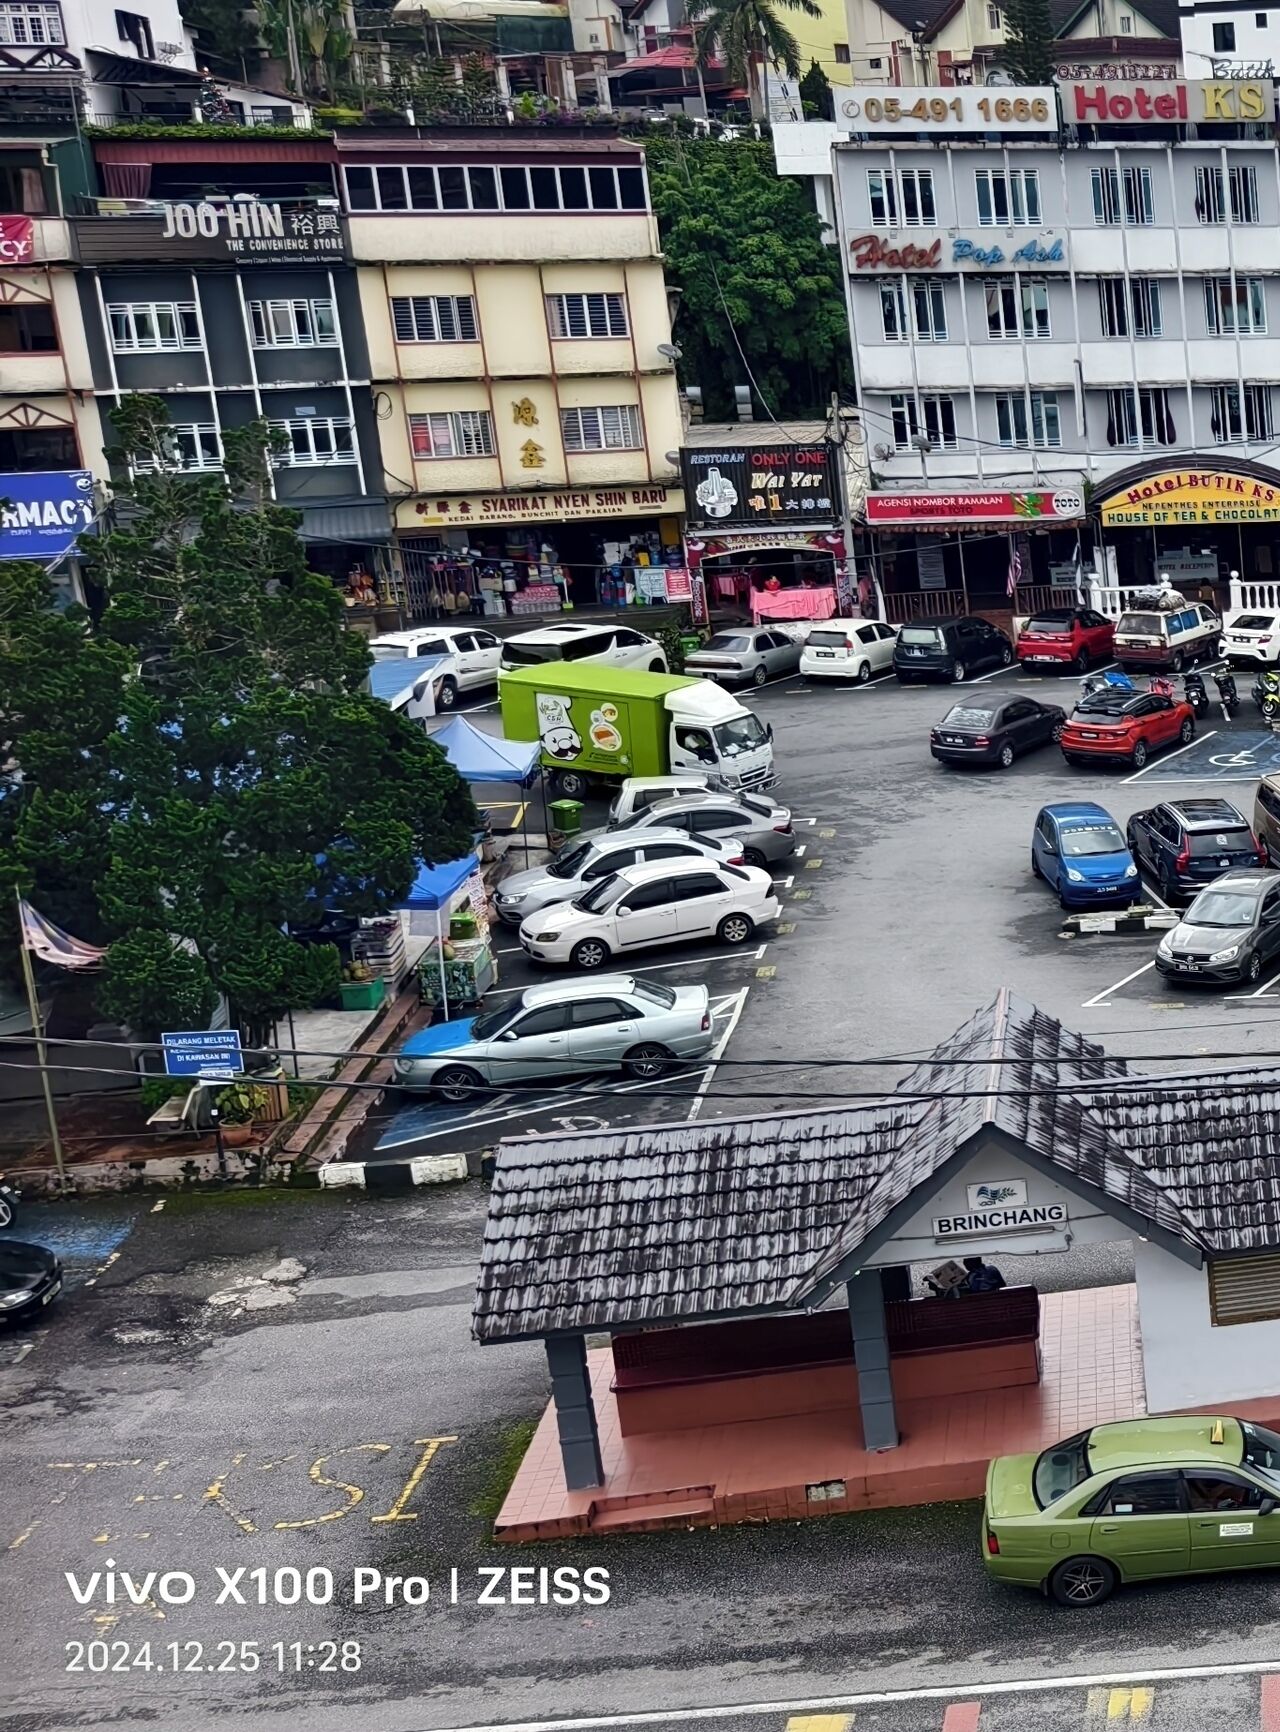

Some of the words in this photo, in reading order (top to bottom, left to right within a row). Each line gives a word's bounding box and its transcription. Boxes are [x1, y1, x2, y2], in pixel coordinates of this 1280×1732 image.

[1074, 85, 1188, 120] Hotel
[1202, 84, 1266, 119] KS
[865, 98, 963, 122] 05-491
[978, 98, 1049, 122] 1666
[163, 203, 219, 239] JOO
[226, 203, 285, 238] HIN
[226, 239, 245, 251] THE
[250, 238, 309, 251] CONVENIENCE
[314, 236, 344, 249] STORE
[850, 235, 942, 269] Hotel
[691, 453, 745, 465] RESTORAN
[752, 453, 791, 466] ONLY
[795, 451, 826, 464] ONE
[1127, 475, 1182, 504] Hotel
[1188, 474, 1245, 493] BUTIK
[1252, 484, 1276, 502] KS
[482, 496, 548, 514] SYARIKAT
[553, 493, 590, 509] NYEN
[596, 490, 628, 506] SHIN
[632, 489, 668, 505] BARU
[877, 499, 912, 507] AGENSI
[914, 498, 957, 507] NOMBOR
[959, 496, 1003, 505] RAMALAN
[1055, 499, 1080, 507] TOTO
[1142, 502, 1199, 511] NEPENTHES
[1202, 500, 1261, 509] ENTERPRISE
[586, 507, 623, 515] PAKAIAN
[949, 506, 974, 515] TOTO
[1108, 512, 1149, 523] HOUSE
[1153, 512, 1169, 522] OF
[1173, 511, 1197, 521] TEA
[1201, 511, 1210, 520] &
[166, 1038, 201, 1046] DILARANG
[204, 1036, 236, 1044] MELETAK
[938, 1206, 1063, 1234] BRINCHANG
